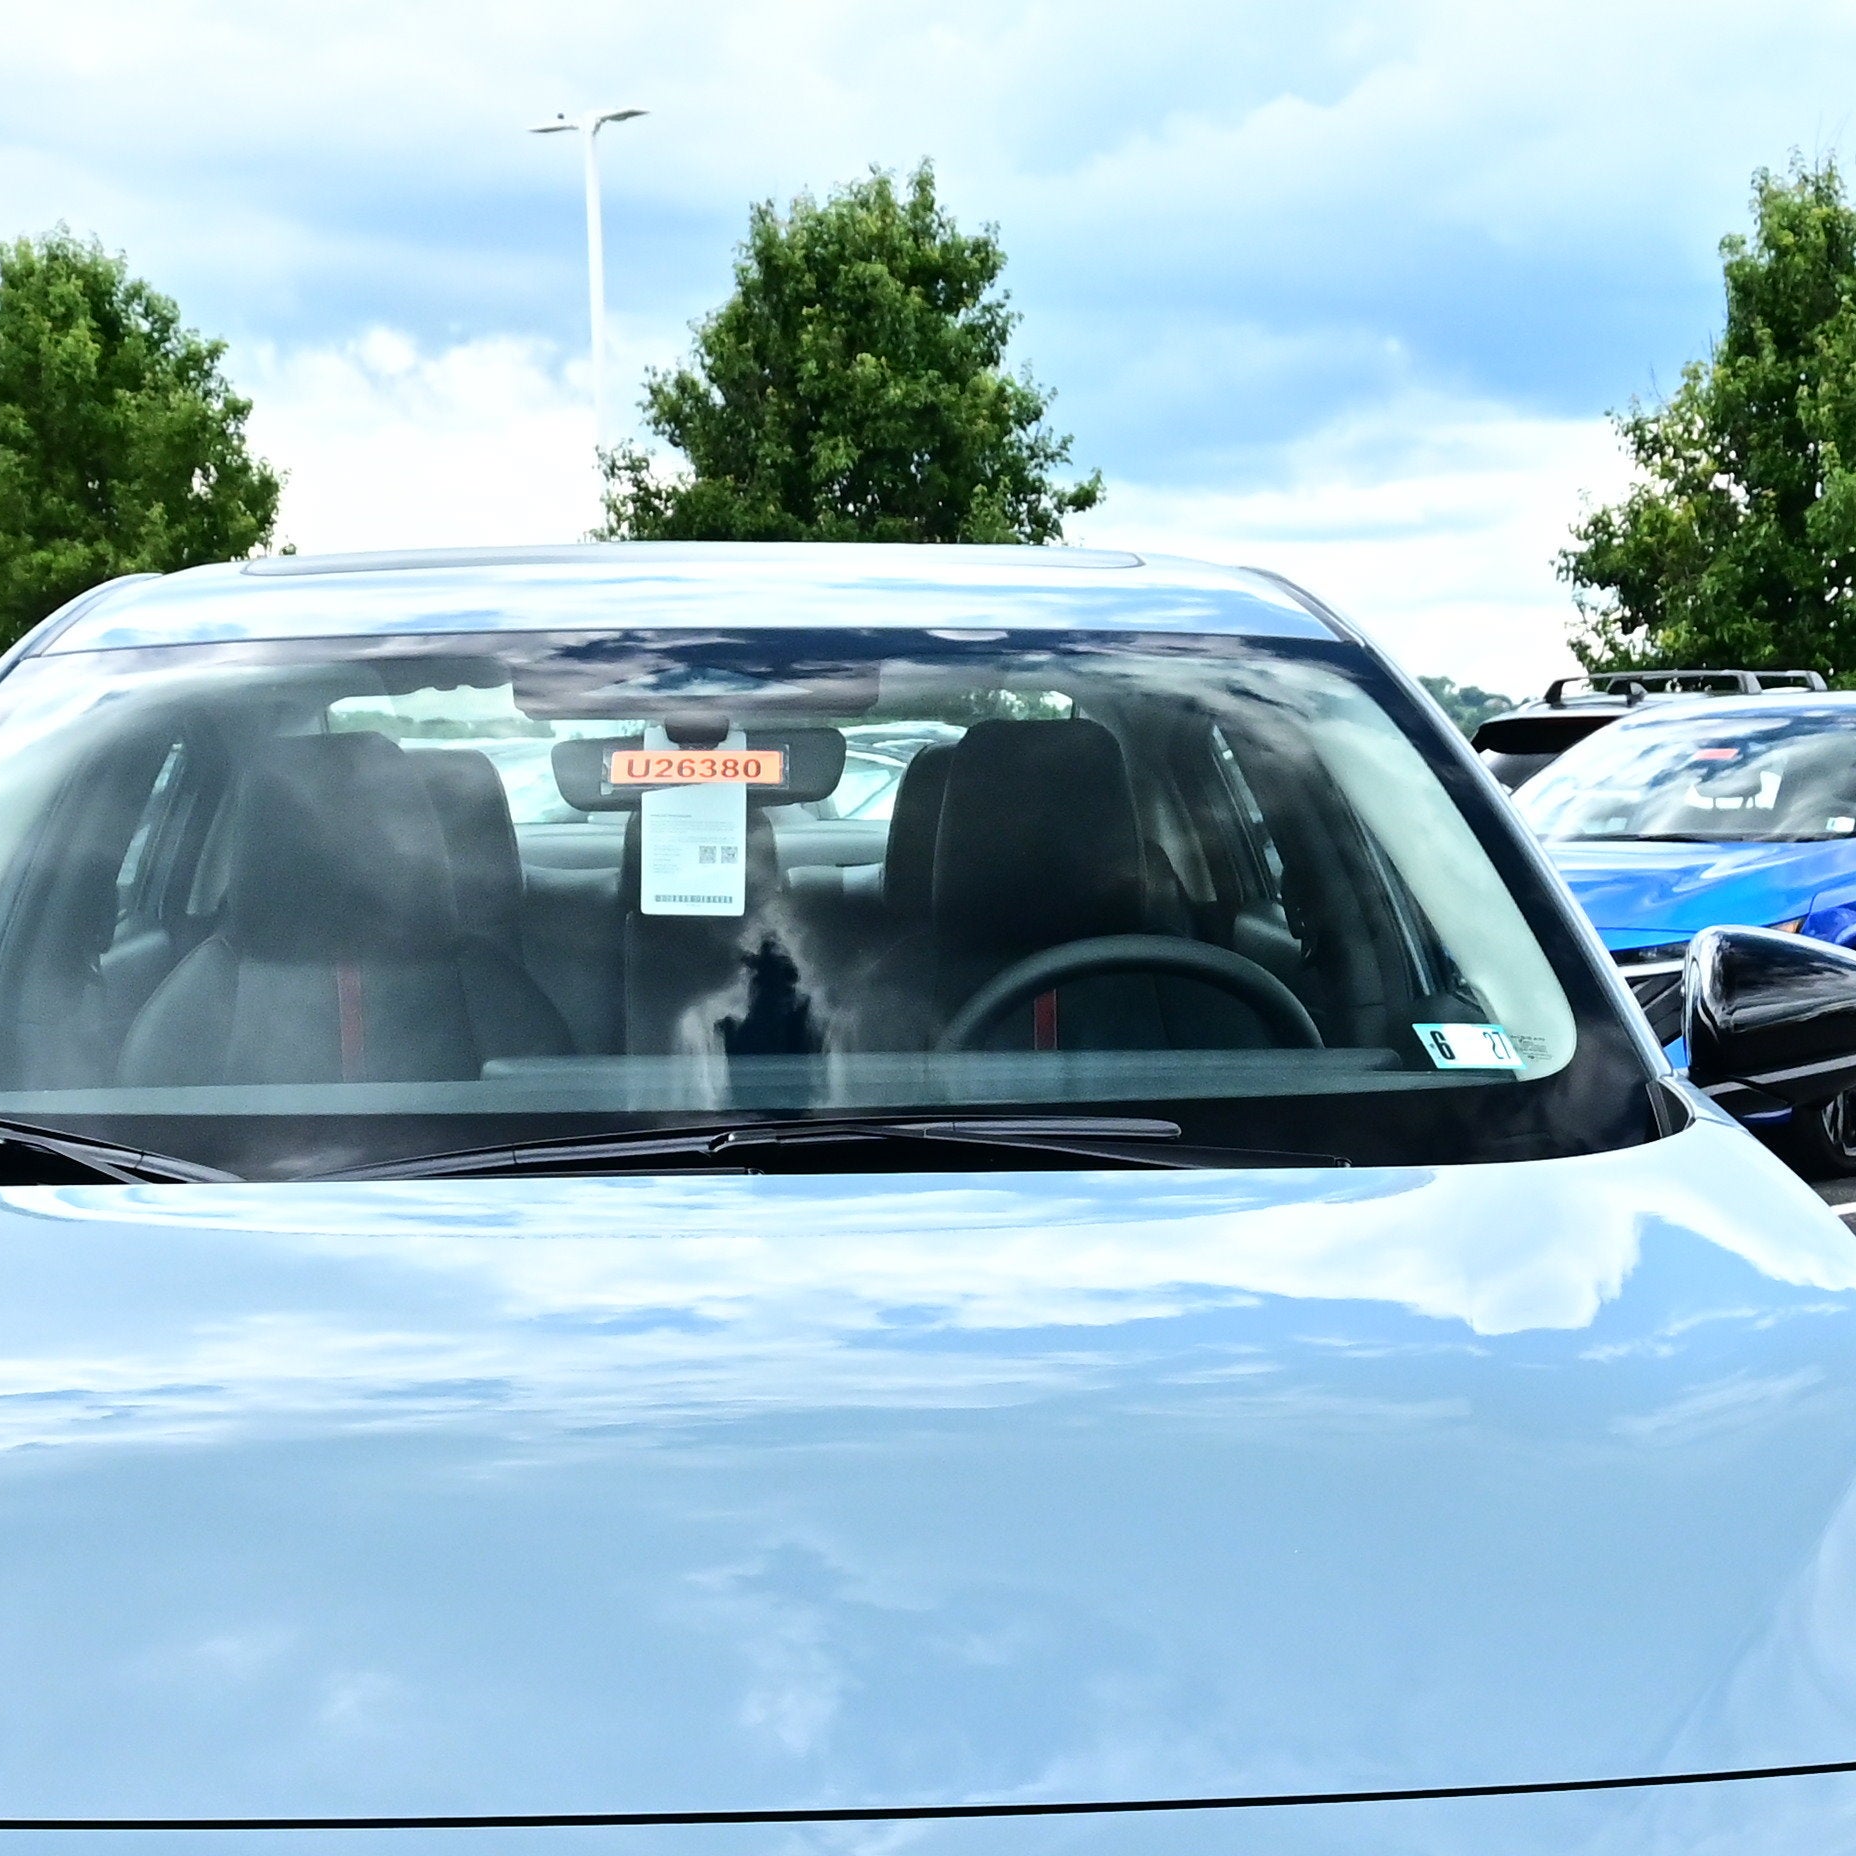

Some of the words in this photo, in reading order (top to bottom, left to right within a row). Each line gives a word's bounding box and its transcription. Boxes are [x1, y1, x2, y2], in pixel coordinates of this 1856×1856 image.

[627, 758, 762, 778] U26380
[1430, 1030, 1456, 1060] 6
[1482, 1031, 1511, 1060] 27
